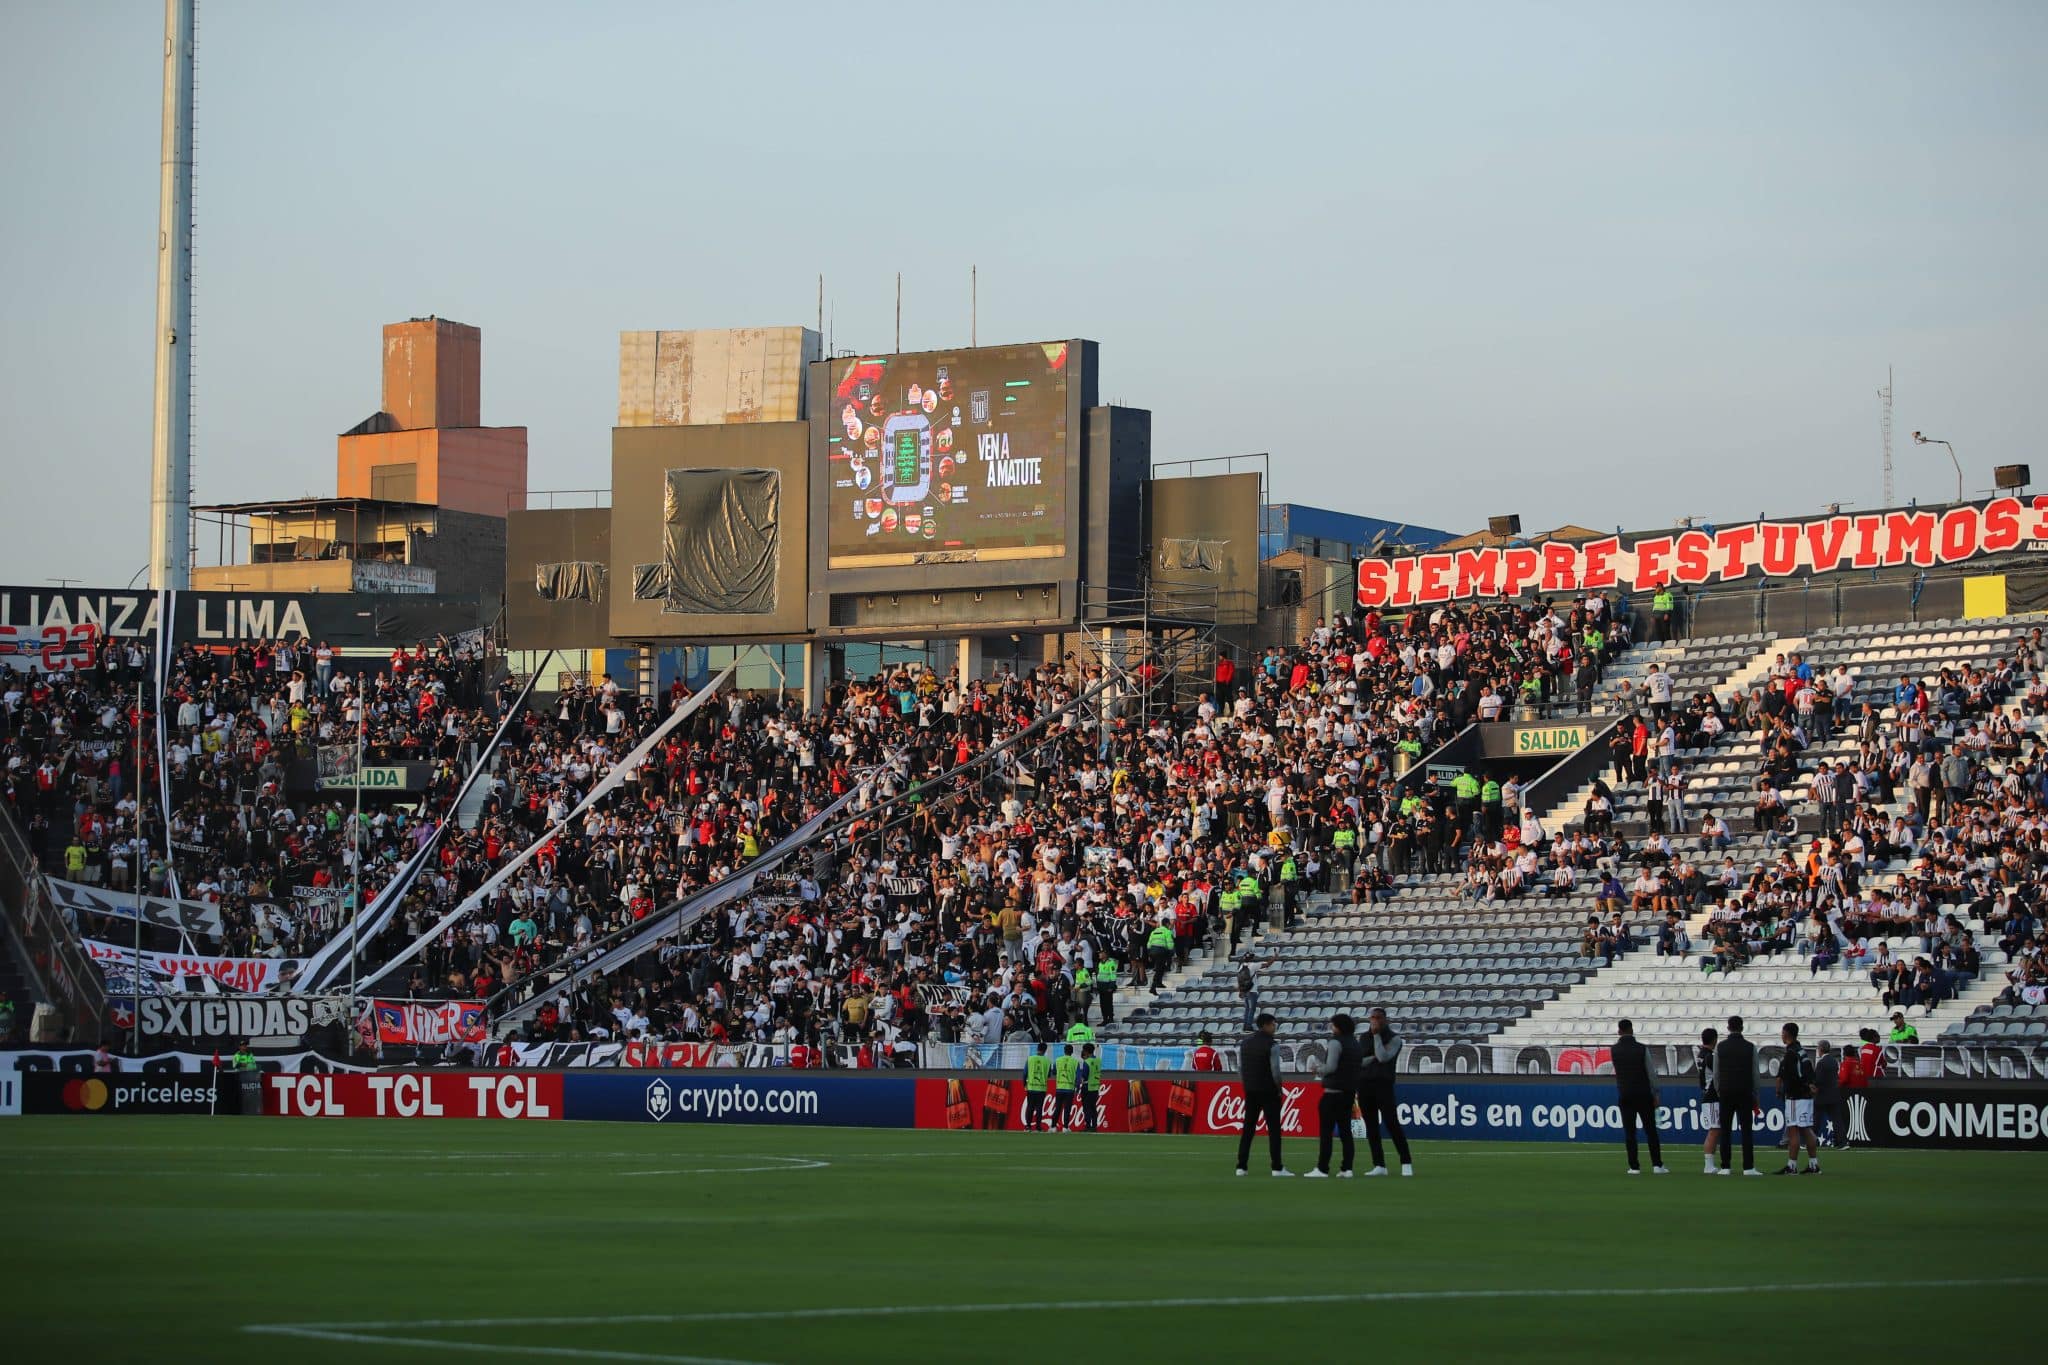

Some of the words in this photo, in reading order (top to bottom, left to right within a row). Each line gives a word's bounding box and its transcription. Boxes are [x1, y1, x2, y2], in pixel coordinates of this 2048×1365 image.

[977, 433, 1000, 460] VEN
[1000, 433, 1010, 459] A
[987, 460, 996, 487] A
[997, 458, 1042, 486] MATUTE
[1358, 537, 1619, 607] SIEMPRE
[1633, 497, 2023, 592] ESTUVIMOS
[197, 599, 310, 639] LIMA
[42, 625, 96, 670] 23
[1520, 729, 1580, 751] SALIDA
[140, 997, 309, 1037] SXICIDAS
[115, 1082, 218, 1108] priceless
[271, 1075, 345, 1117] TCL
[367, 1074, 444, 1118] TCL
[468, 1075, 550, 1119] TCL
[679, 1083, 819, 1118] crypto.com
[1487, 1104, 1522, 1127] en
